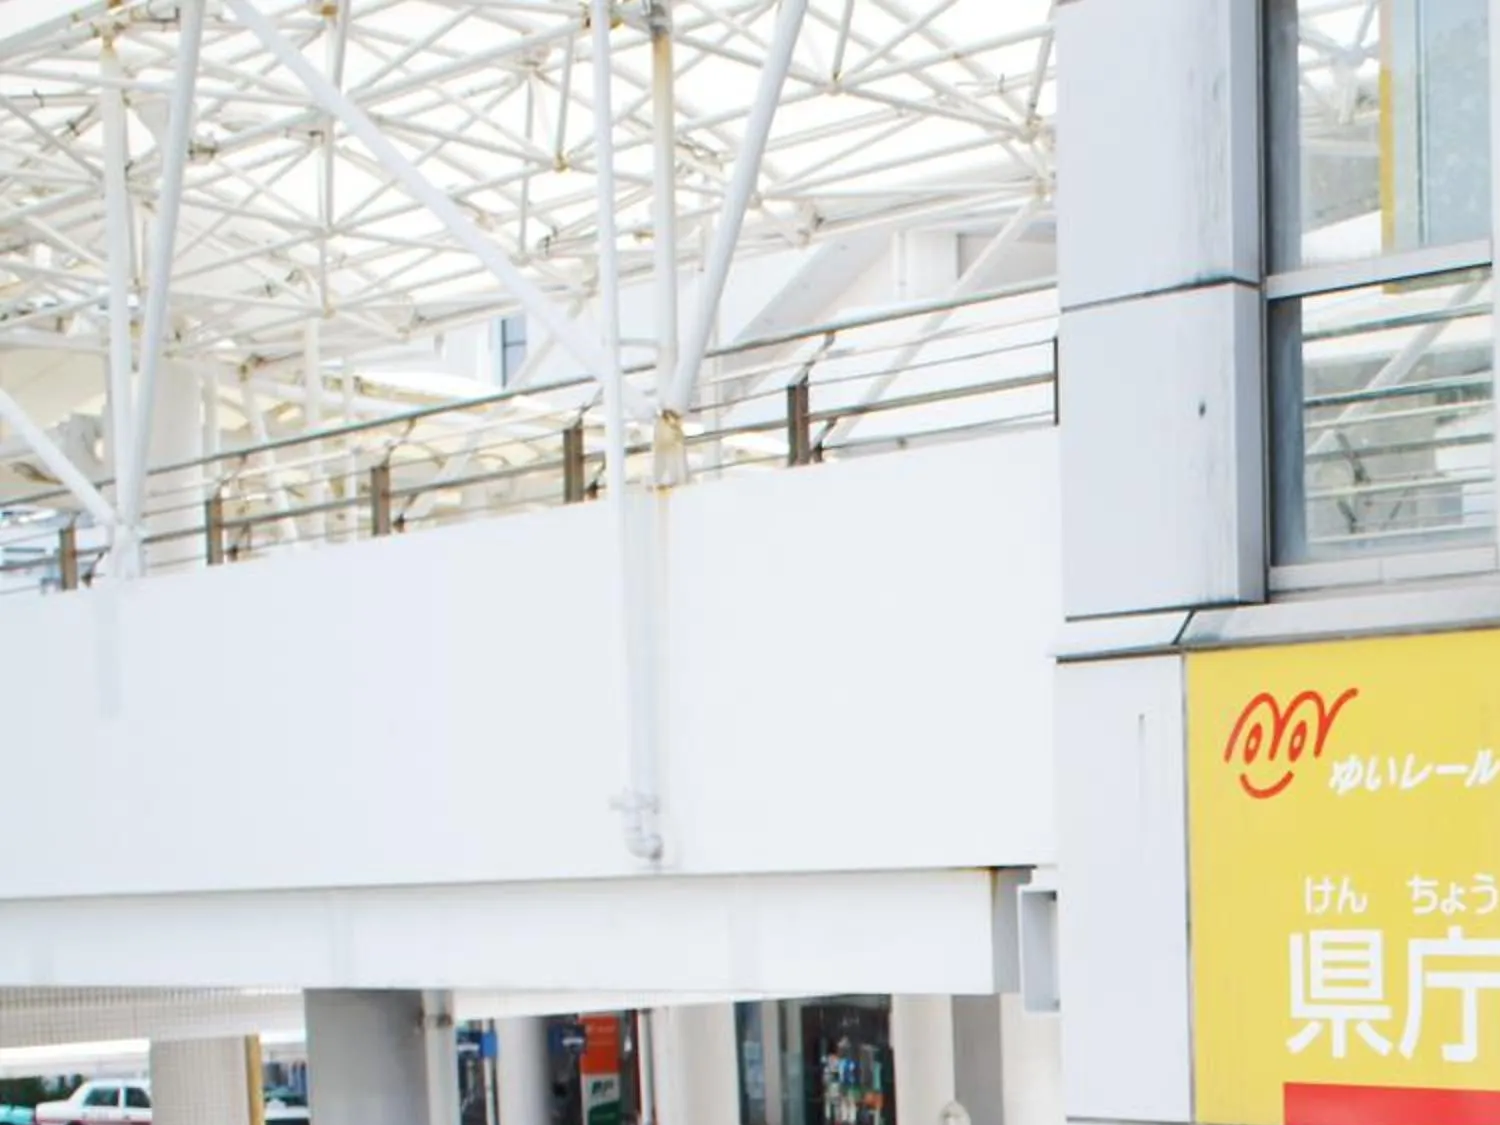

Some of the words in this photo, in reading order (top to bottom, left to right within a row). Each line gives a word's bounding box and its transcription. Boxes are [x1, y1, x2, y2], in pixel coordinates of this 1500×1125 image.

[1303, 874, 1367, 914] けん
[1406, 872, 1500, 916] ちょう
